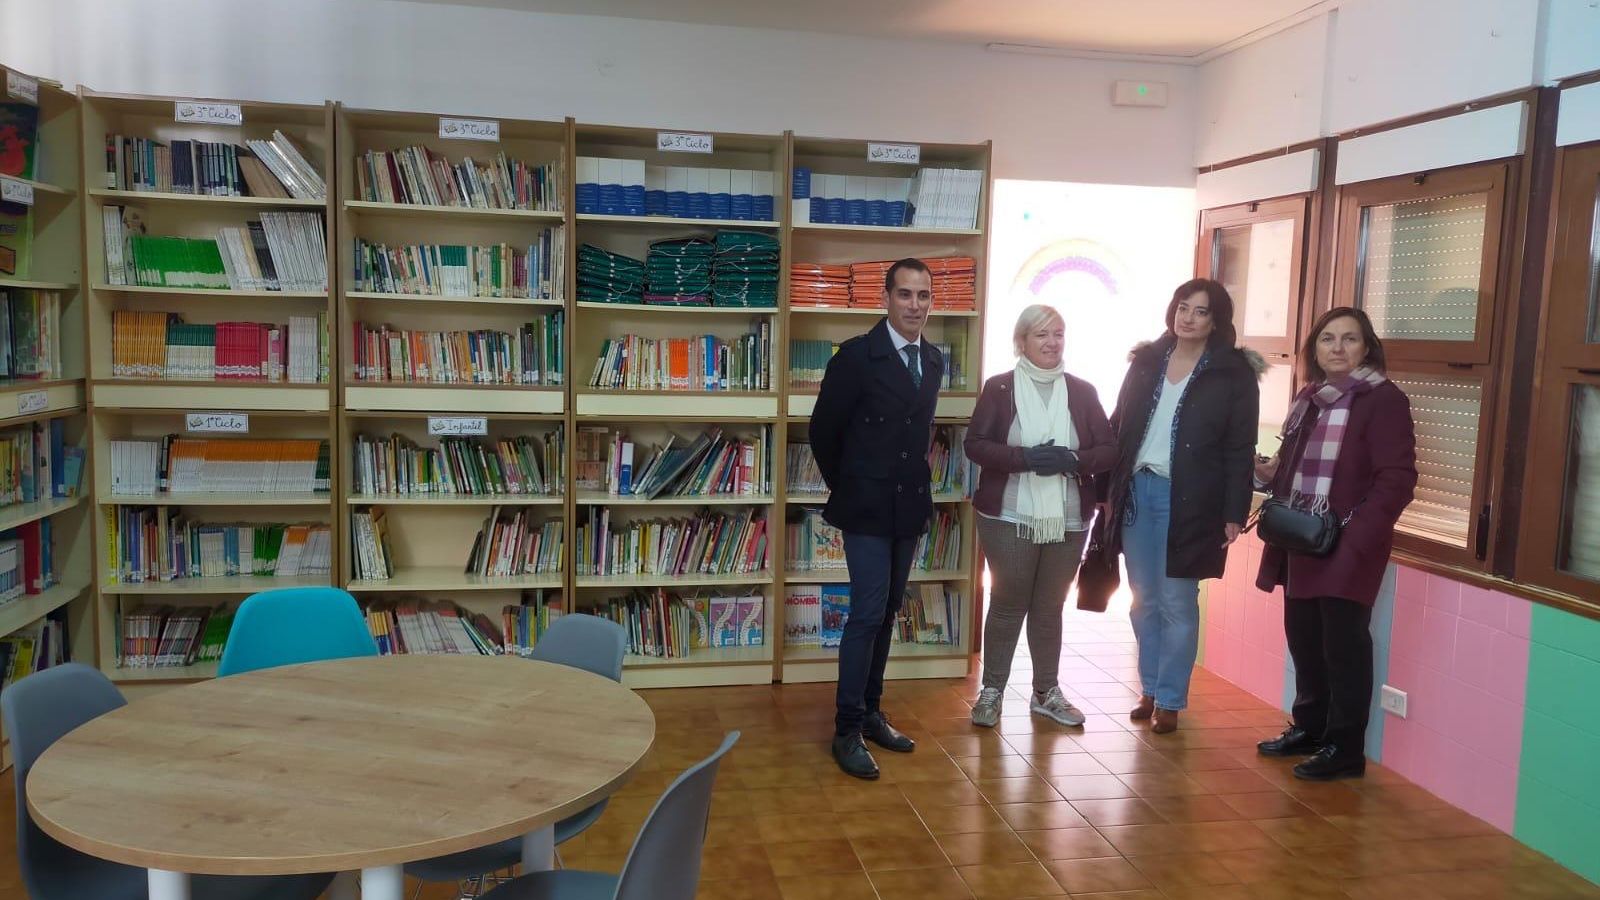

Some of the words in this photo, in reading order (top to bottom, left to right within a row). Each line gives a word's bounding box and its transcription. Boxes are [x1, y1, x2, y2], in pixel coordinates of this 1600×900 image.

[470, 124, 496, 137] Ciclo
[686, 136, 709, 149] Ciclo
[893, 147, 917, 160] Ciclo
[214, 416, 242, 429] Ciclo
[444, 419, 483, 434] Infantil
